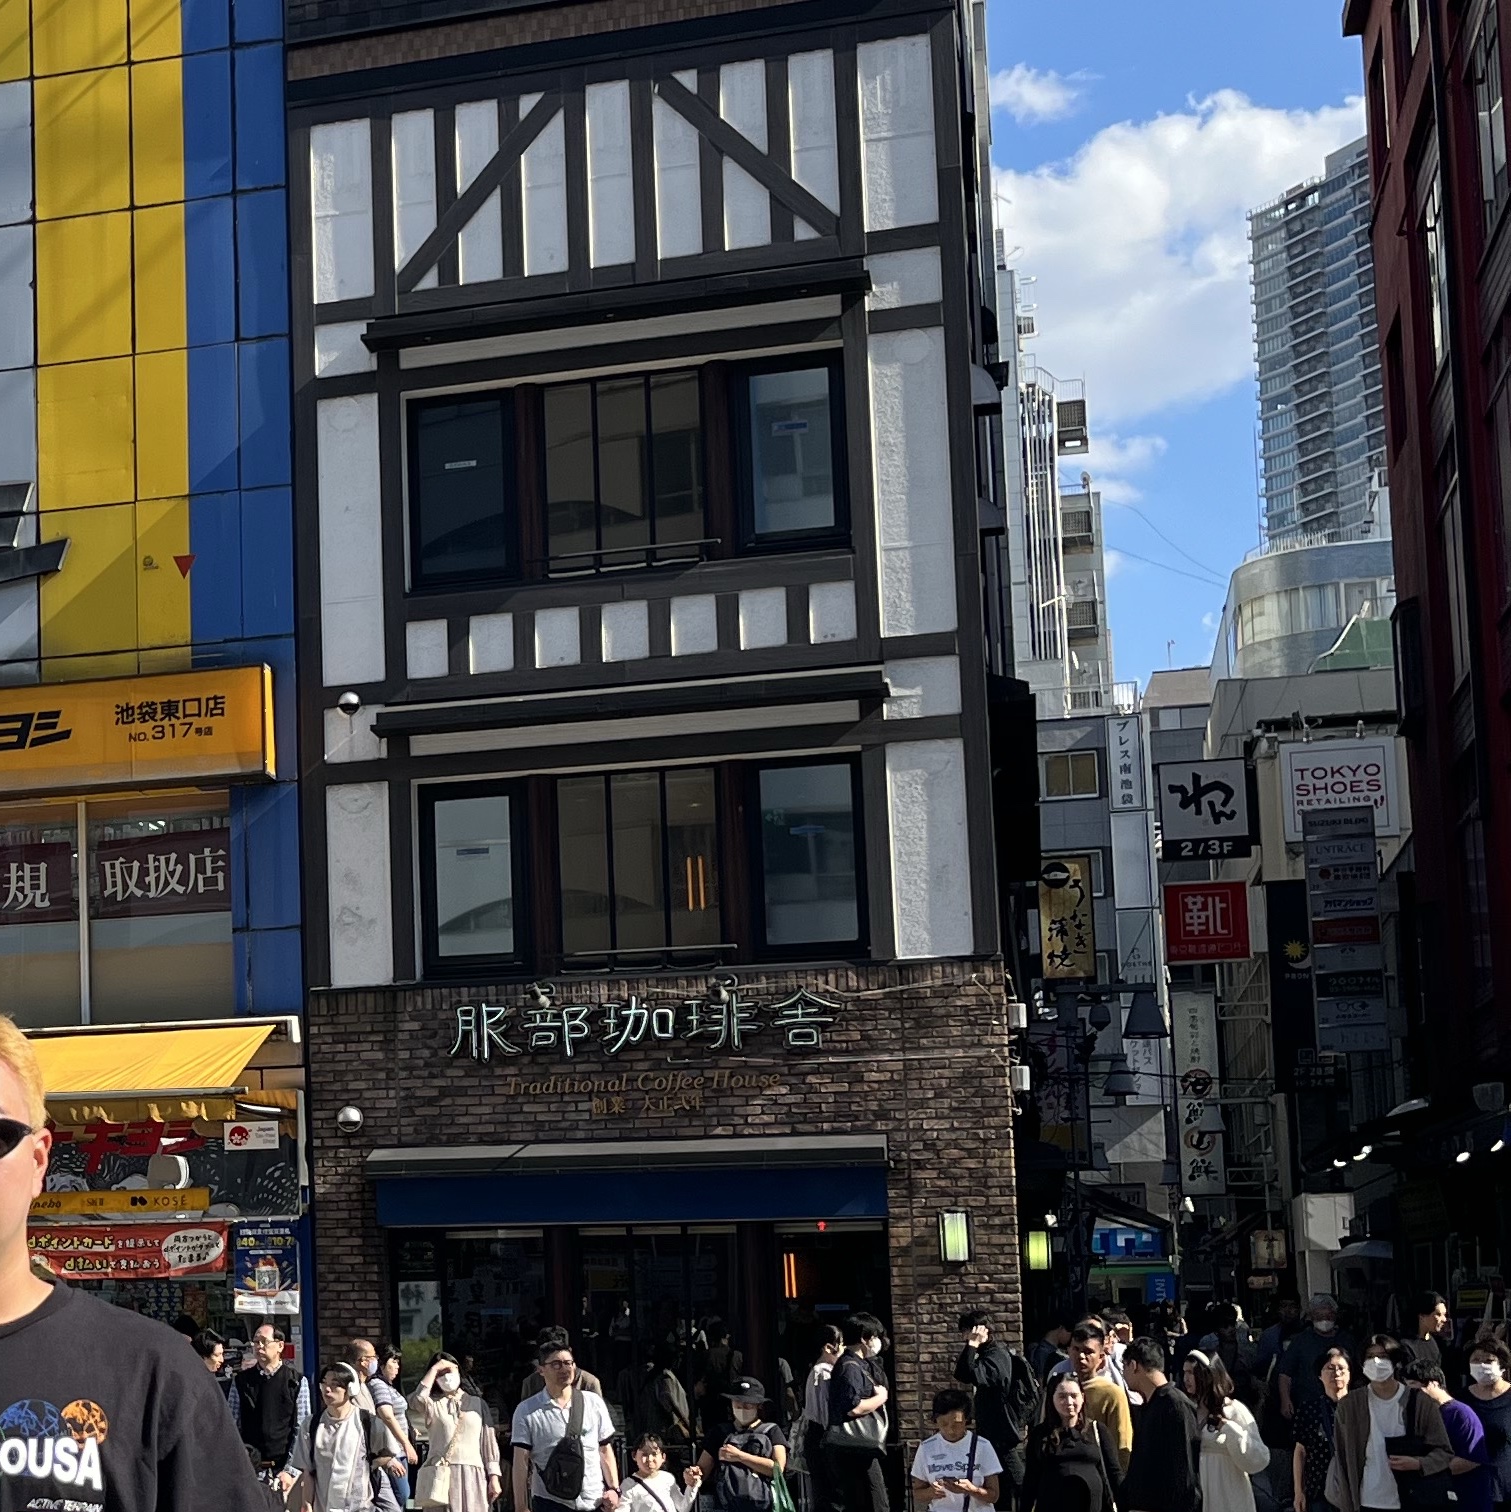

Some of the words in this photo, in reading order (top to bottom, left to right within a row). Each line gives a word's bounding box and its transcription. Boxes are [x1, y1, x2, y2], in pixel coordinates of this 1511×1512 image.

[113, 694, 226, 726] 池袋東口店
[1294, 763, 1381, 780] TOKYO
[1295, 779, 1382, 797] SHOES
[1296, 795, 1372, 807] RETAILING
[102, 849, 226, 902] 取扱店
[1069, 878, 1087, 954] うなぎ
[1184, 894, 1229, 936] 靴
[1047, 917, 1075, 969] 蒲焼
[446, 986, 844, 1063] 服部珈琲舎
[505, 1074, 628, 1097] Traditional
[636, 1074, 705, 1096] Coffee
[711, 1070, 782, 1089] House
[26, 1497, 63, 1511] ACTIVE
